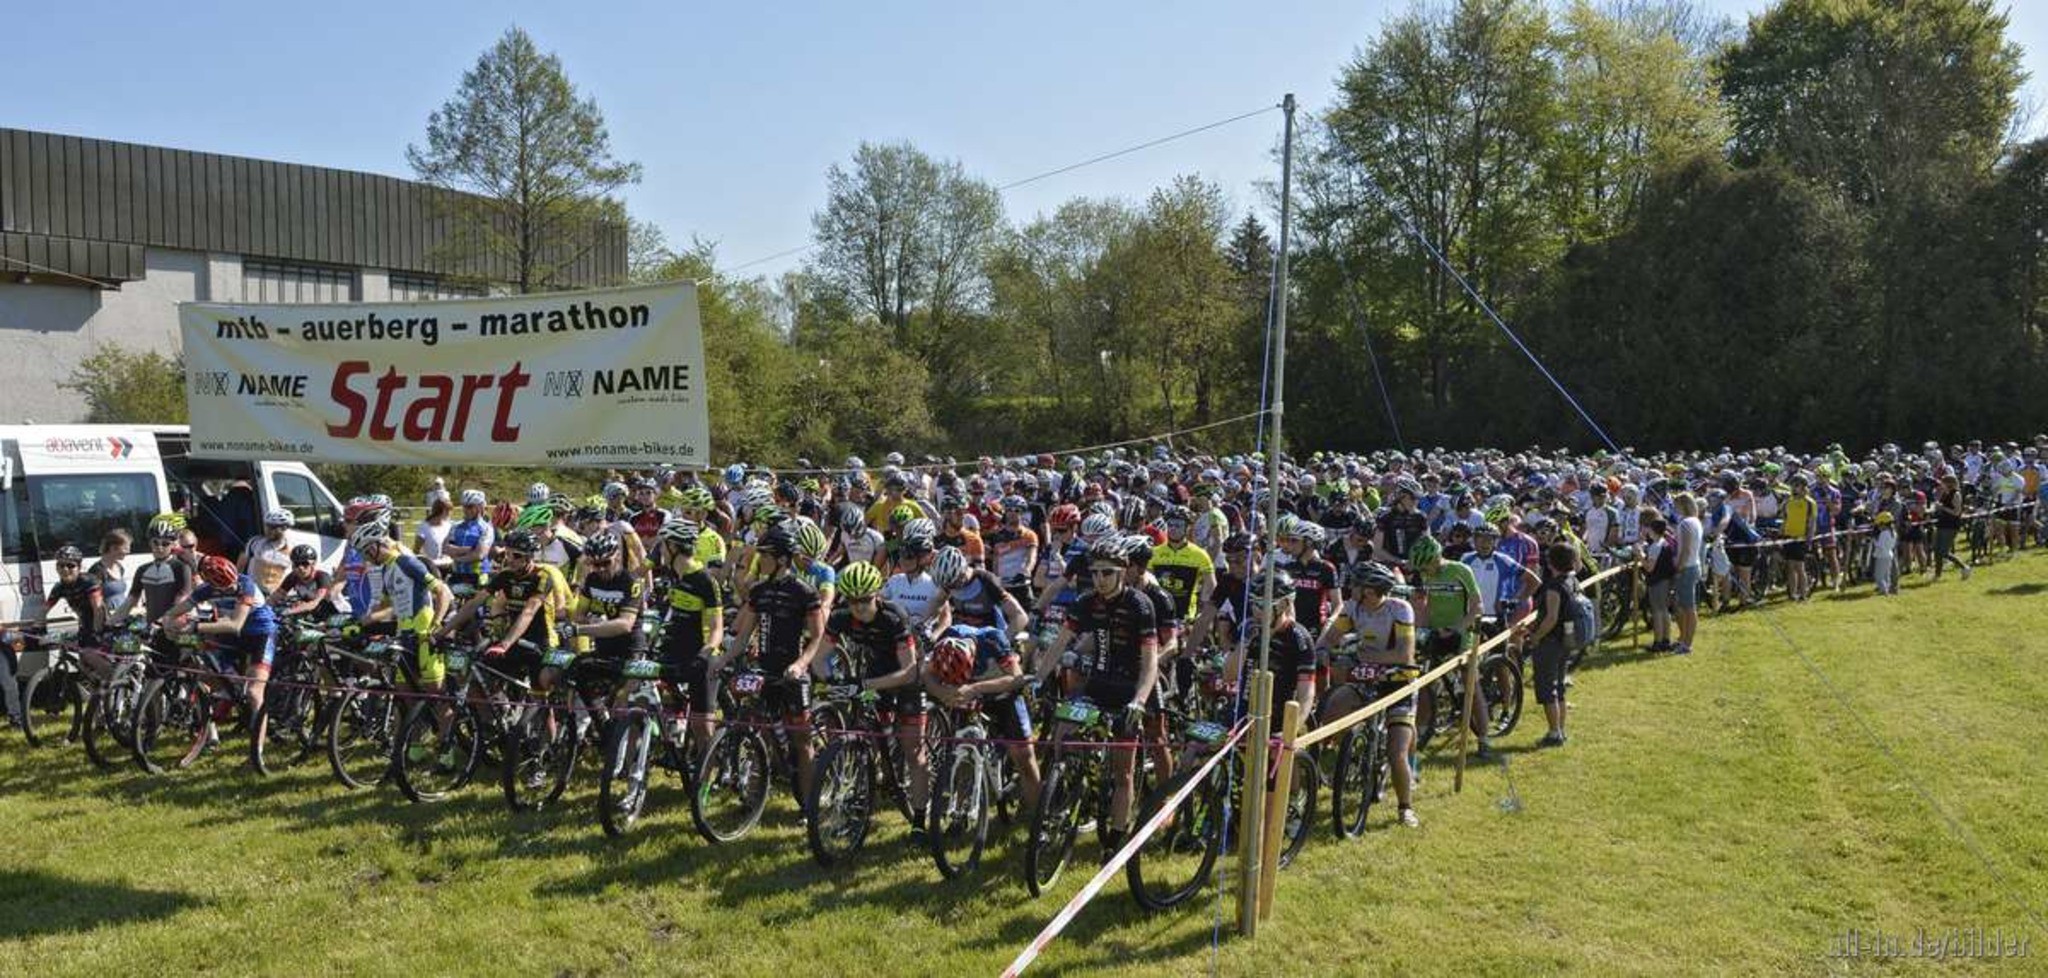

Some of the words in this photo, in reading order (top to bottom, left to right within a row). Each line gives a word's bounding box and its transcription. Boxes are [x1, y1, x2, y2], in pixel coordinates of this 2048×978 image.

[216, 316, 269, 339] mtb
[302, 313, 438, 346] auerberg
[479, 301, 650, 336] marathon
[237, 373, 309, 398] NAME
[592, 365, 690, 396] NAME
[324, 359, 531, 443] Start
[45, 437, 104, 452] abavent
[545, 442, 695, 459] www.noname-bikes.de
